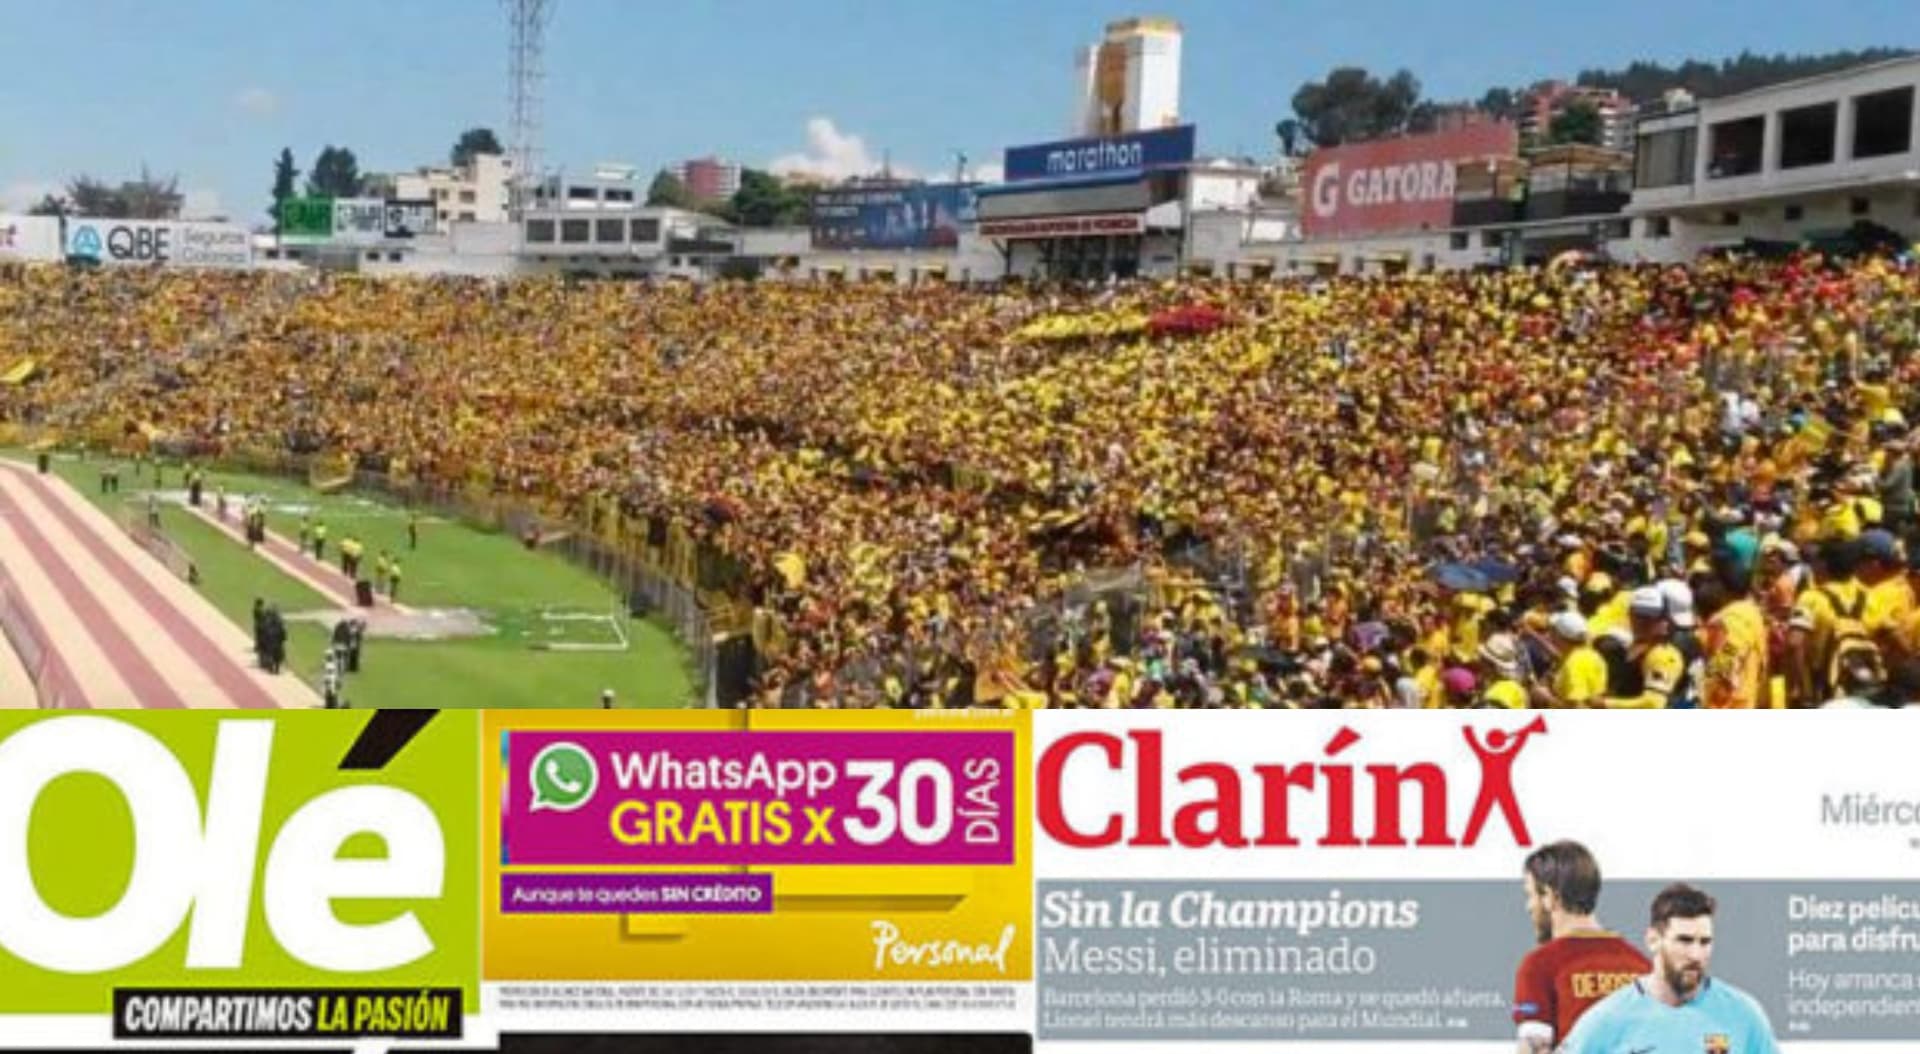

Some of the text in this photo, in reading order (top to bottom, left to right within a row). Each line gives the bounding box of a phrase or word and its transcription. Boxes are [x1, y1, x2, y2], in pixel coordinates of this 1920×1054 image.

[1046, 141, 1143, 172] marathon
[107, 225, 171, 260] QBE
[611, 752, 837, 797] WhatsApp
[1035, 725, 1457, 849] Clarín
[842, 758, 954, 845] 30
[958, 757, 1000, 844] DÍAS
[1821, 793, 1920, 824] Miérc
[0, 709, 446, 974] Olé
[609, 800, 835, 844] GRATIS x
[512, 883, 763, 905] Aunque te quedes SIN CRÉDITO
[1041, 889, 1421, 936] Sin la Champions
[1789, 895, 1845, 920] Diez
[869, 919, 1017, 973] Personal
[1043, 936, 1378, 978] Messi, eliminado
[1788, 931, 1847, 955] para
[1230, 991, 1265, 1008] con
[1288, 986, 1343, 1007] Roma
[1788, 968, 1913, 1000] Hoy arranca
[125, 989, 449, 1031] COMPARTIMOS LA PASIÓN
